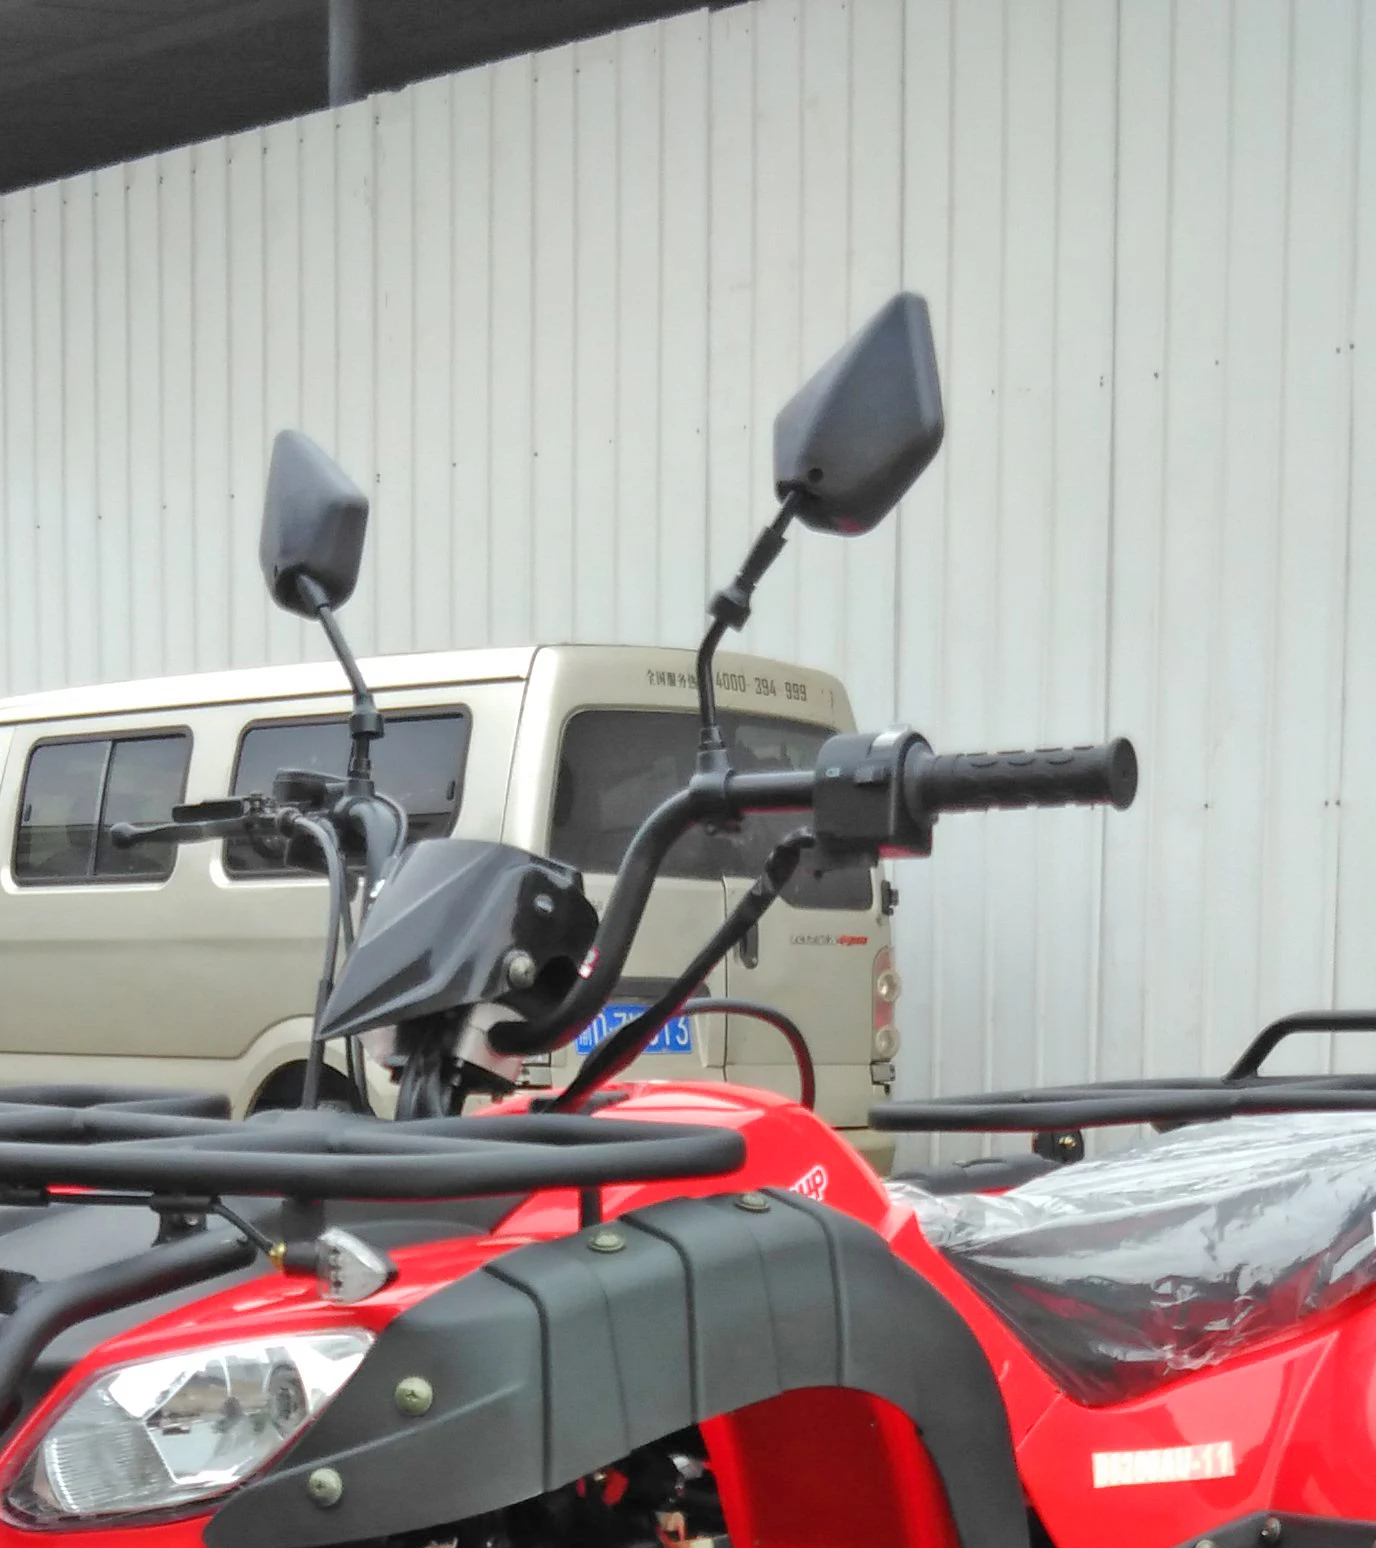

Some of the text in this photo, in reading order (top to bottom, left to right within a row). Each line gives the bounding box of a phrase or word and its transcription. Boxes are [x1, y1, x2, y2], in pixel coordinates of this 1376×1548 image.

[645, 668, 698, 690] 全国服务热
